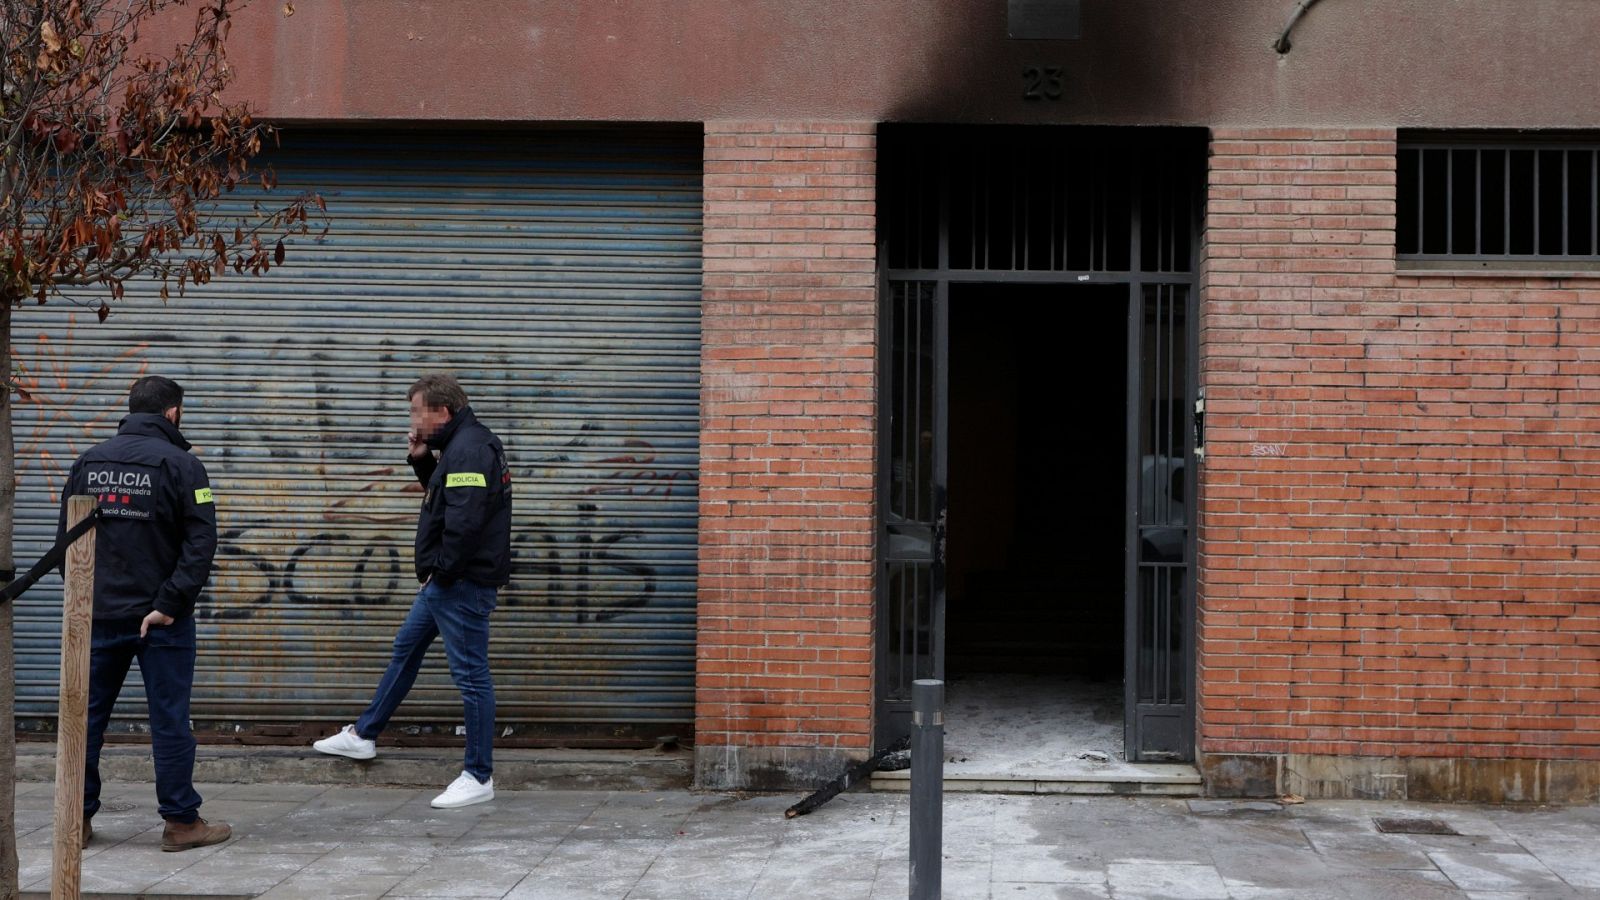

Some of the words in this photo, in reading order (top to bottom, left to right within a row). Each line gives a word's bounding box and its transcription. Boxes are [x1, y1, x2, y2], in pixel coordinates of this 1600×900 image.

[1022, 65, 1064, 101] 23
[87, 471, 152, 487] POLICIA
[111, 486, 152, 496] d'esquadra
[120, 508, 150, 518] Criminal
